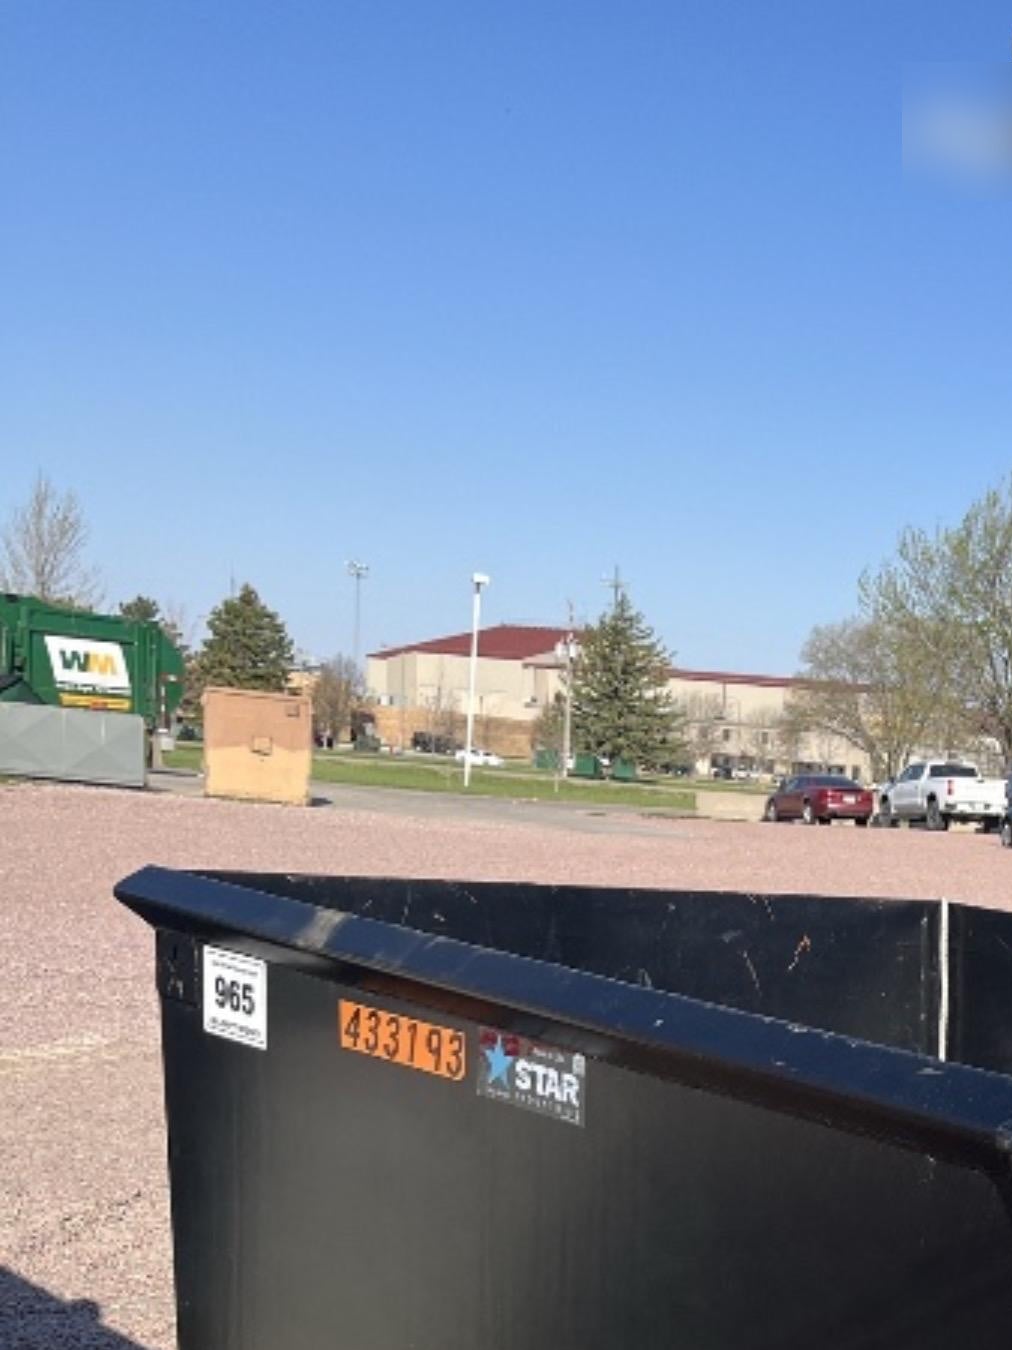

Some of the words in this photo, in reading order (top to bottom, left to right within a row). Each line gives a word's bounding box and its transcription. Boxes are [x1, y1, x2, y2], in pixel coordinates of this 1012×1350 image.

[59, 649, 117, 675] WM
[214, 975, 255, 1015] 965
[343, 1007, 463, 1077] 433193
[515, 1058, 579, 1107] STAR
